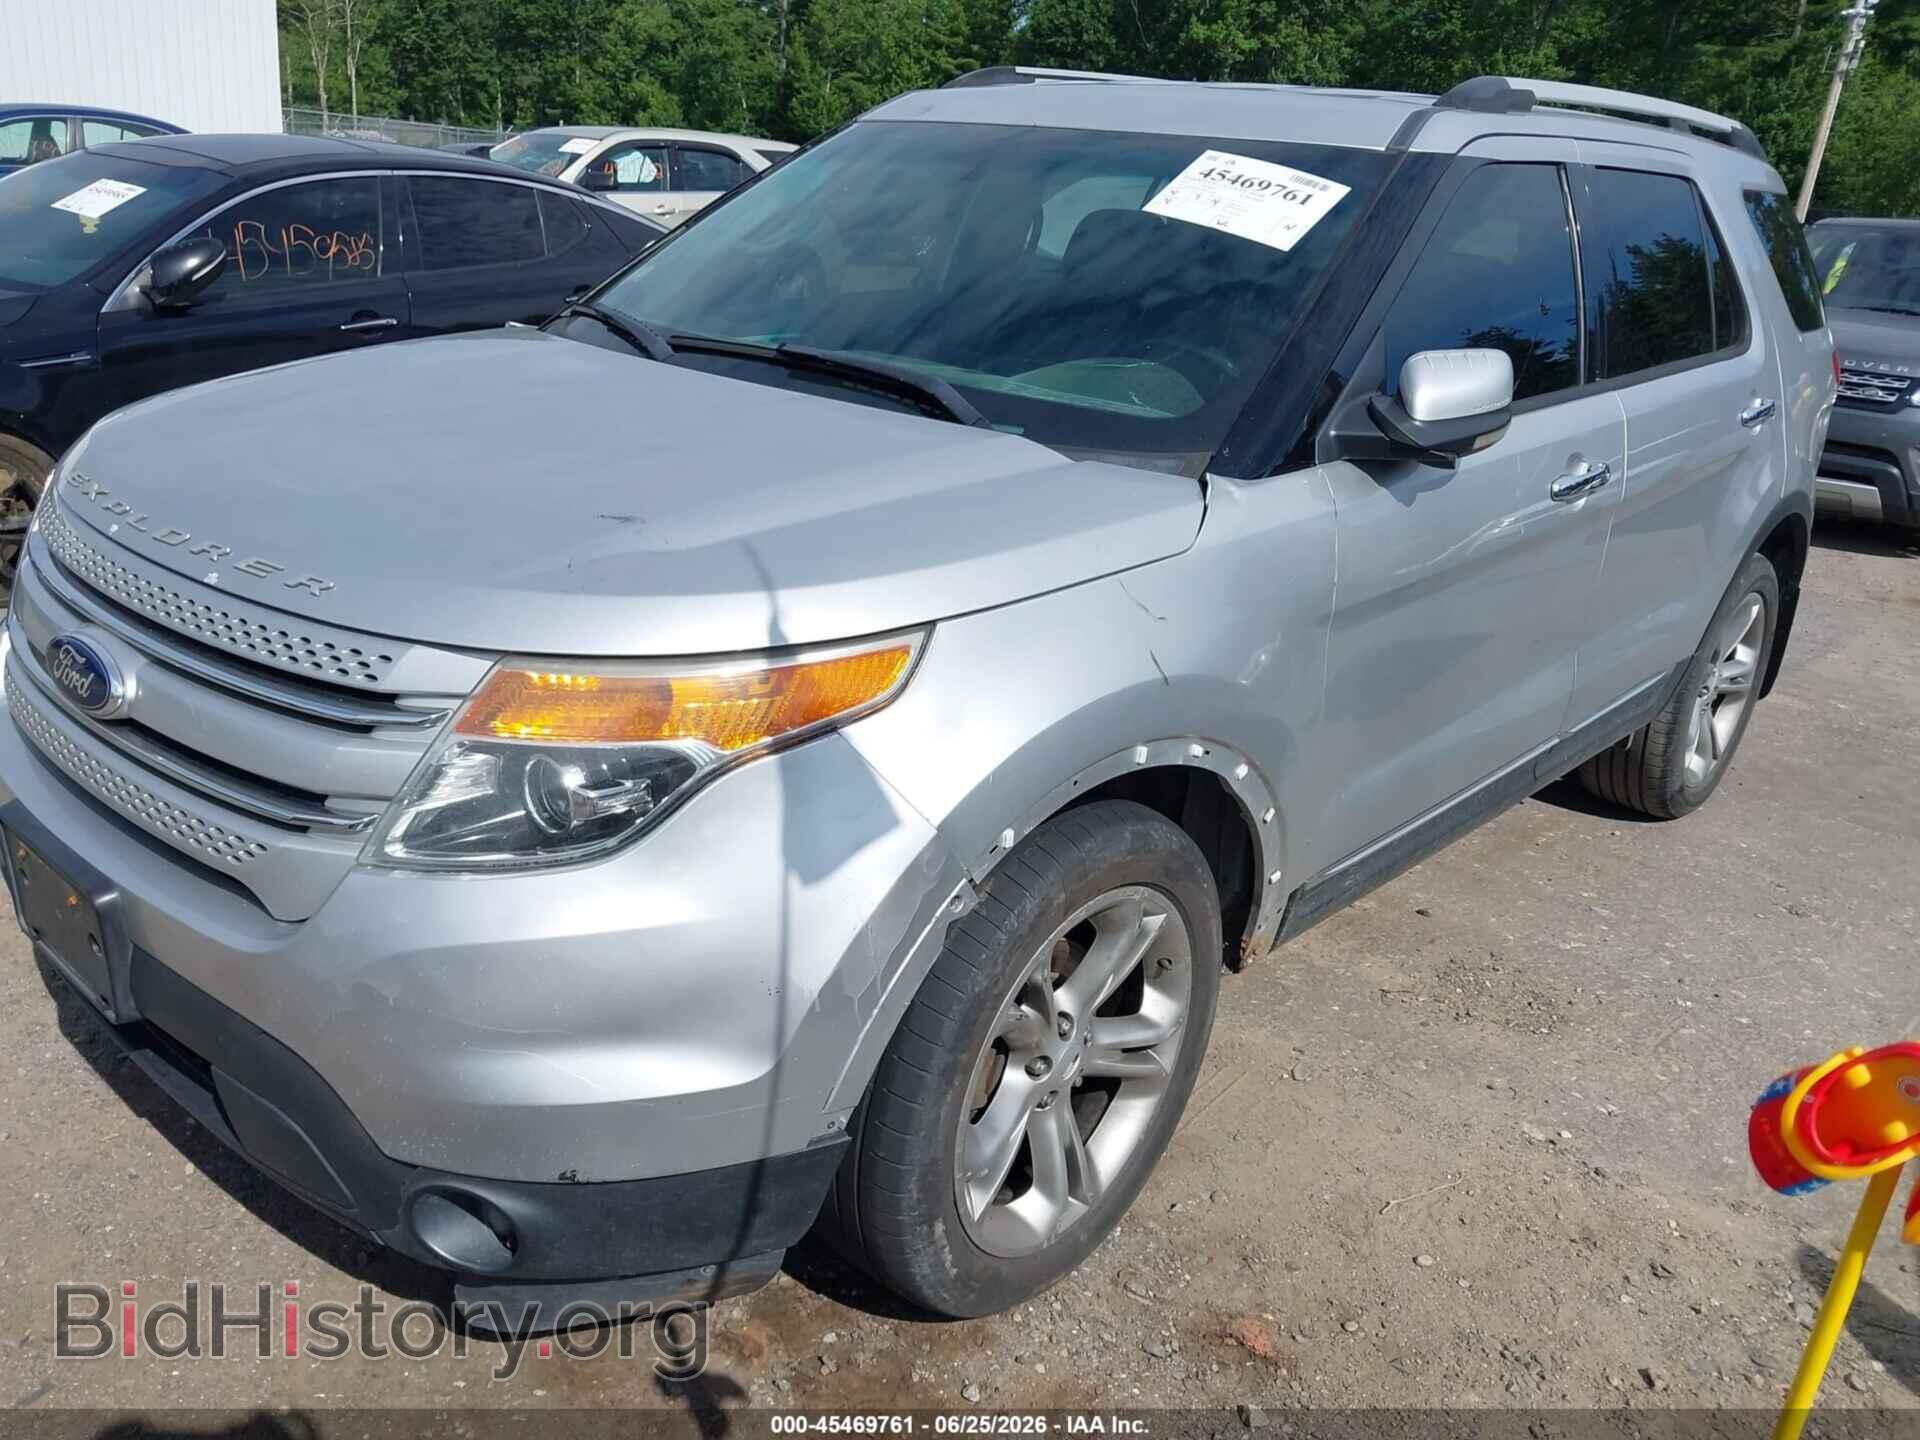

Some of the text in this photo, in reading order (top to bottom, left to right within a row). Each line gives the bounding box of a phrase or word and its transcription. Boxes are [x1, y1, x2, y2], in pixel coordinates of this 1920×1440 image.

[1199, 166, 1316, 207] 45469761
[66, 471, 337, 598] EXPLORER
[52, 643, 94, 699] Ford
